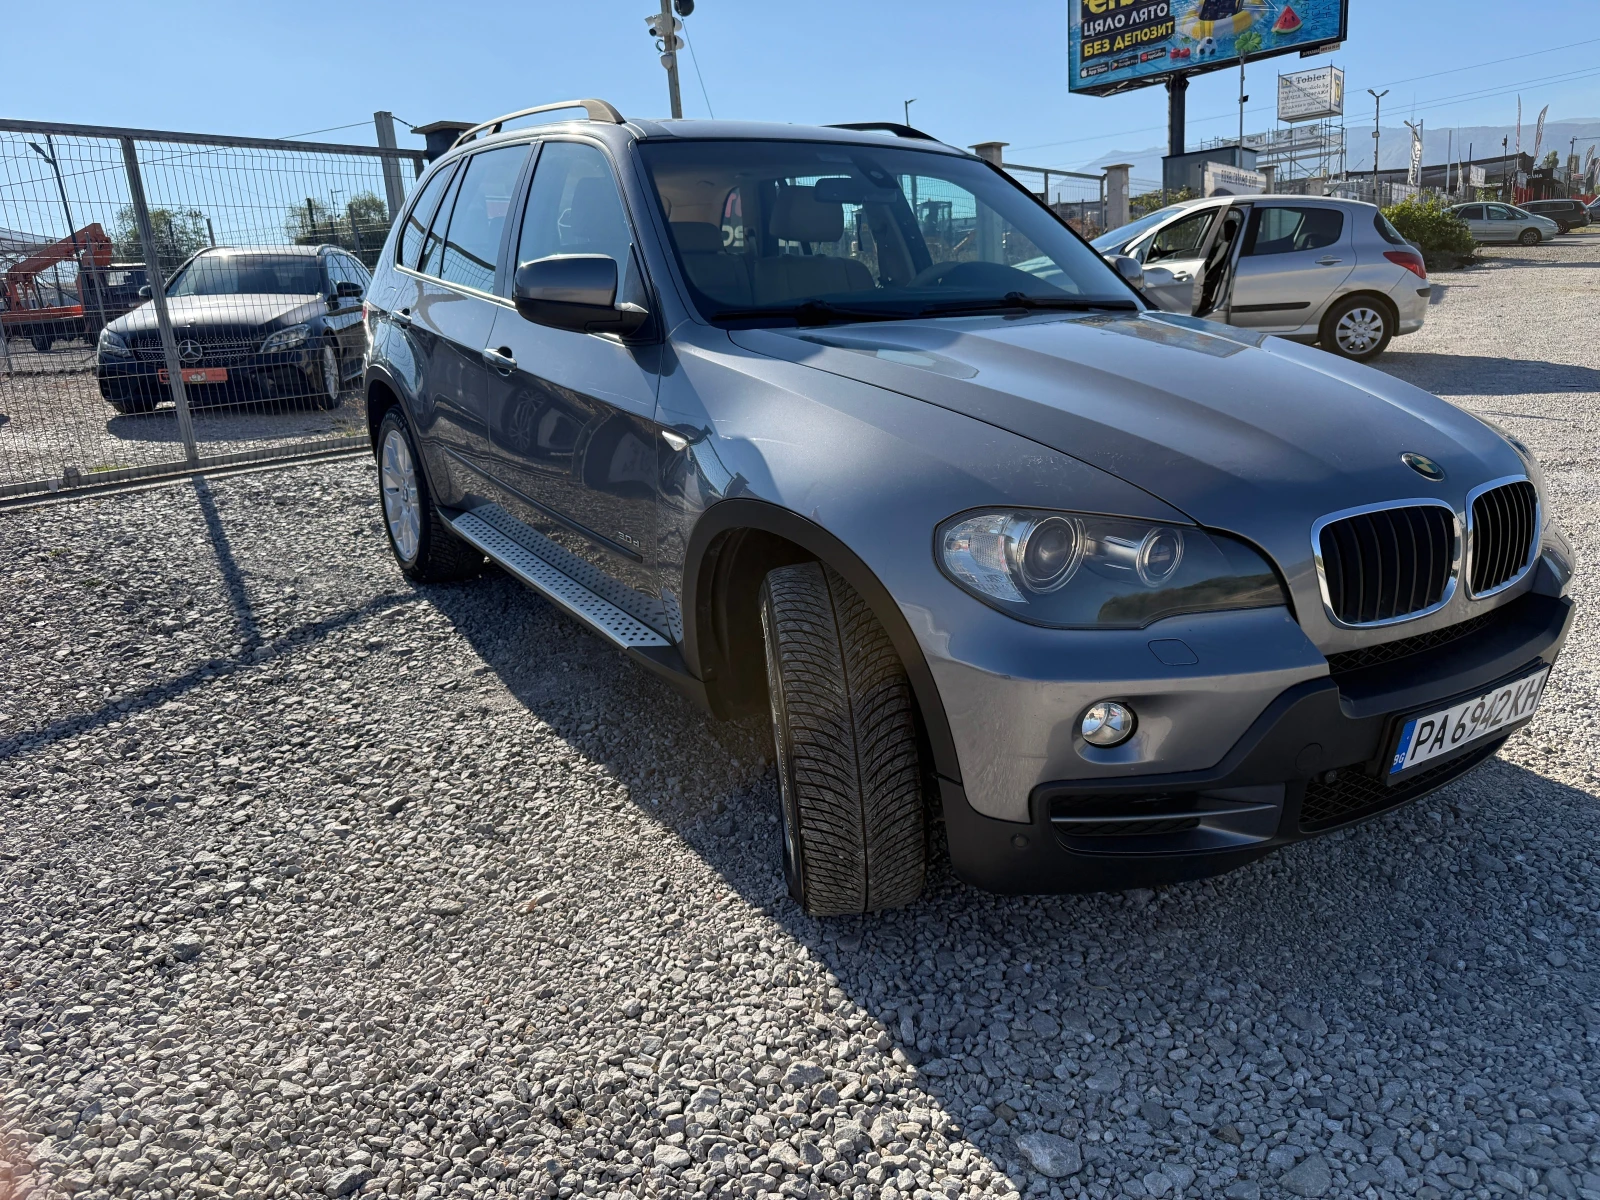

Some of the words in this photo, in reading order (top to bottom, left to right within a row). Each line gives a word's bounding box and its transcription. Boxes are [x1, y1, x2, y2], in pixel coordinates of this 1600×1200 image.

[1084, 14, 1125, 36] ЦЯЛО
[1129, 3, 1168, 25] ЛЯТО
[1084, 39, 1110, 57] БЕЗ
[1113, 21, 1174, 51] ДЕПОЗИТ
[1295, 73, 1327, 85] Tobler
[1393, 752, 1406, 766] BG
